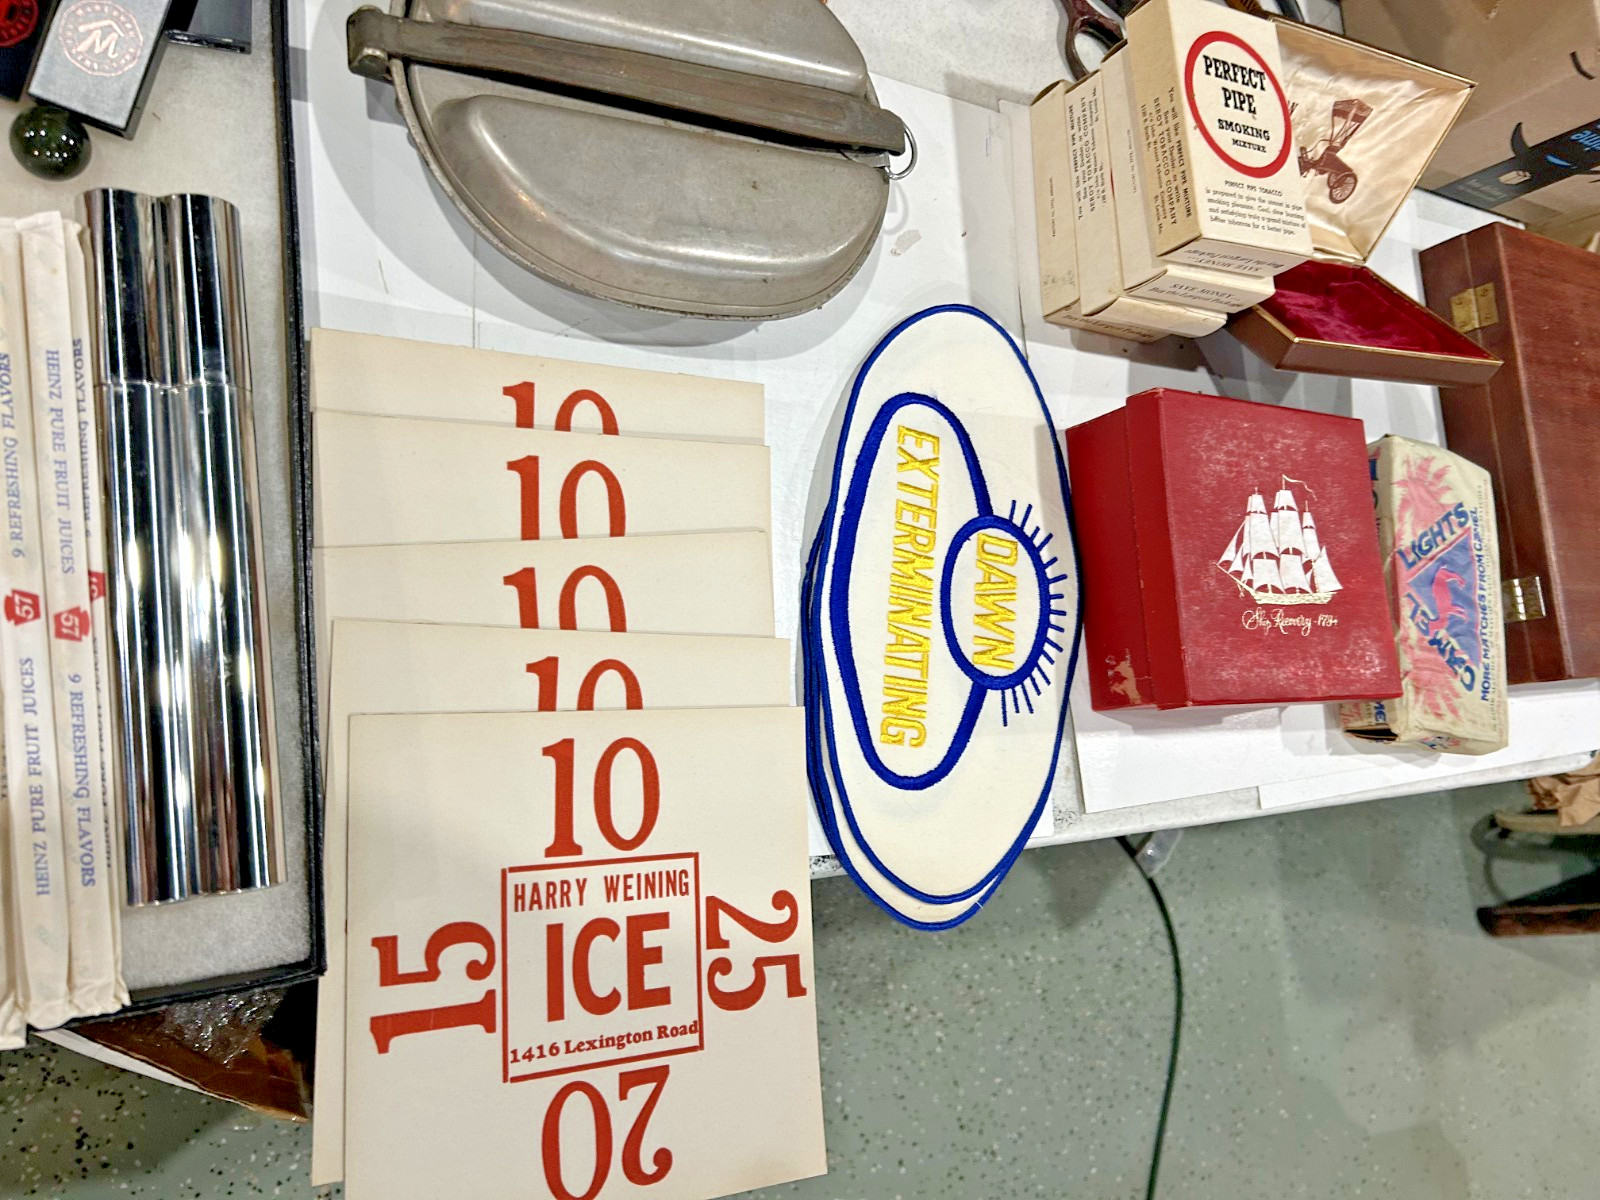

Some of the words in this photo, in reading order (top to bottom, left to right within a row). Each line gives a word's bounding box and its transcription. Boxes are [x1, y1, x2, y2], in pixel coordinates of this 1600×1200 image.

[1203, 54, 1266, 91] PERFECT
[1221, 86, 1257, 115] PIPE
[1218, 118, 1271, 141] SMOKING
[1232, 138, 1267, 153] MIXTURE
[1085, 140, 1093, 182] TOBACCO
[1158, 130, 1170, 177] TOBACCO
[1166, 180, 1177, 225] COMPANY
[1177, 140, 1185, 168] PERFECT
[1183, 187, 1192, 218] MIXTURE
[1224, 180, 1245, 189] PERFECT
[1246, 184, 1257, 192] PIPE
[1259, 187, 1283, 197] TOBACCO
[1171, 282, 1199, 293] SAVE
[0, 353, 15, 429] FLAVORS
[46, 350, 62, 400] HEINZ
[50, 407, 66, 453] PURE
[4, 438, 24, 542] REFRESHING
[54, 459, 70, 511] FRUIT
[506, 454, 626, 541] 10
[12, 547, 25, 559] 9
[58, 517, 75, 575] JUICES
[1397, 501, 1470, 571] LIGHTS
[1470, 507, 1483, 552] CAMEL
[879, 423, 941, 748] EXTERMINATING
[1475, 554, 1486, 591] FROM
[15, 595, 35, 620] 57
[60, 612, 80, 640] 57
[972, 531, 1019, 671] DAWN
[1478, 593, 1490, 659] MATCHES
[19, 657, 37, 717] JUICES
[68, 674, 82, 684] 9
[1481, 662, 1490, 701] MORE
[24, 724, 40, 777] FRUIT
[69, 691, 90, 799] REFRESHING
[29, 783, 46, 833] PURE
[542, 737, 660, 858] 10
[34, 840, 50, 896] HEINZ
[76, 807, 96, 889] FLAVORS
[514, 877, 589, 912] HARRY
[604, 869, 690, 904] WEINING
[546, 911, 672, 1023] ICE
[705, 889, 808, 1012] 25
[369, 921, 497, 1055] 15
[510, 1040, 560, 1064] 1416
[563, 1028, 653, 1056] Lexington
[656, 1020, 700, 1042] Road
[541, 1064, 673, 1200] 20
